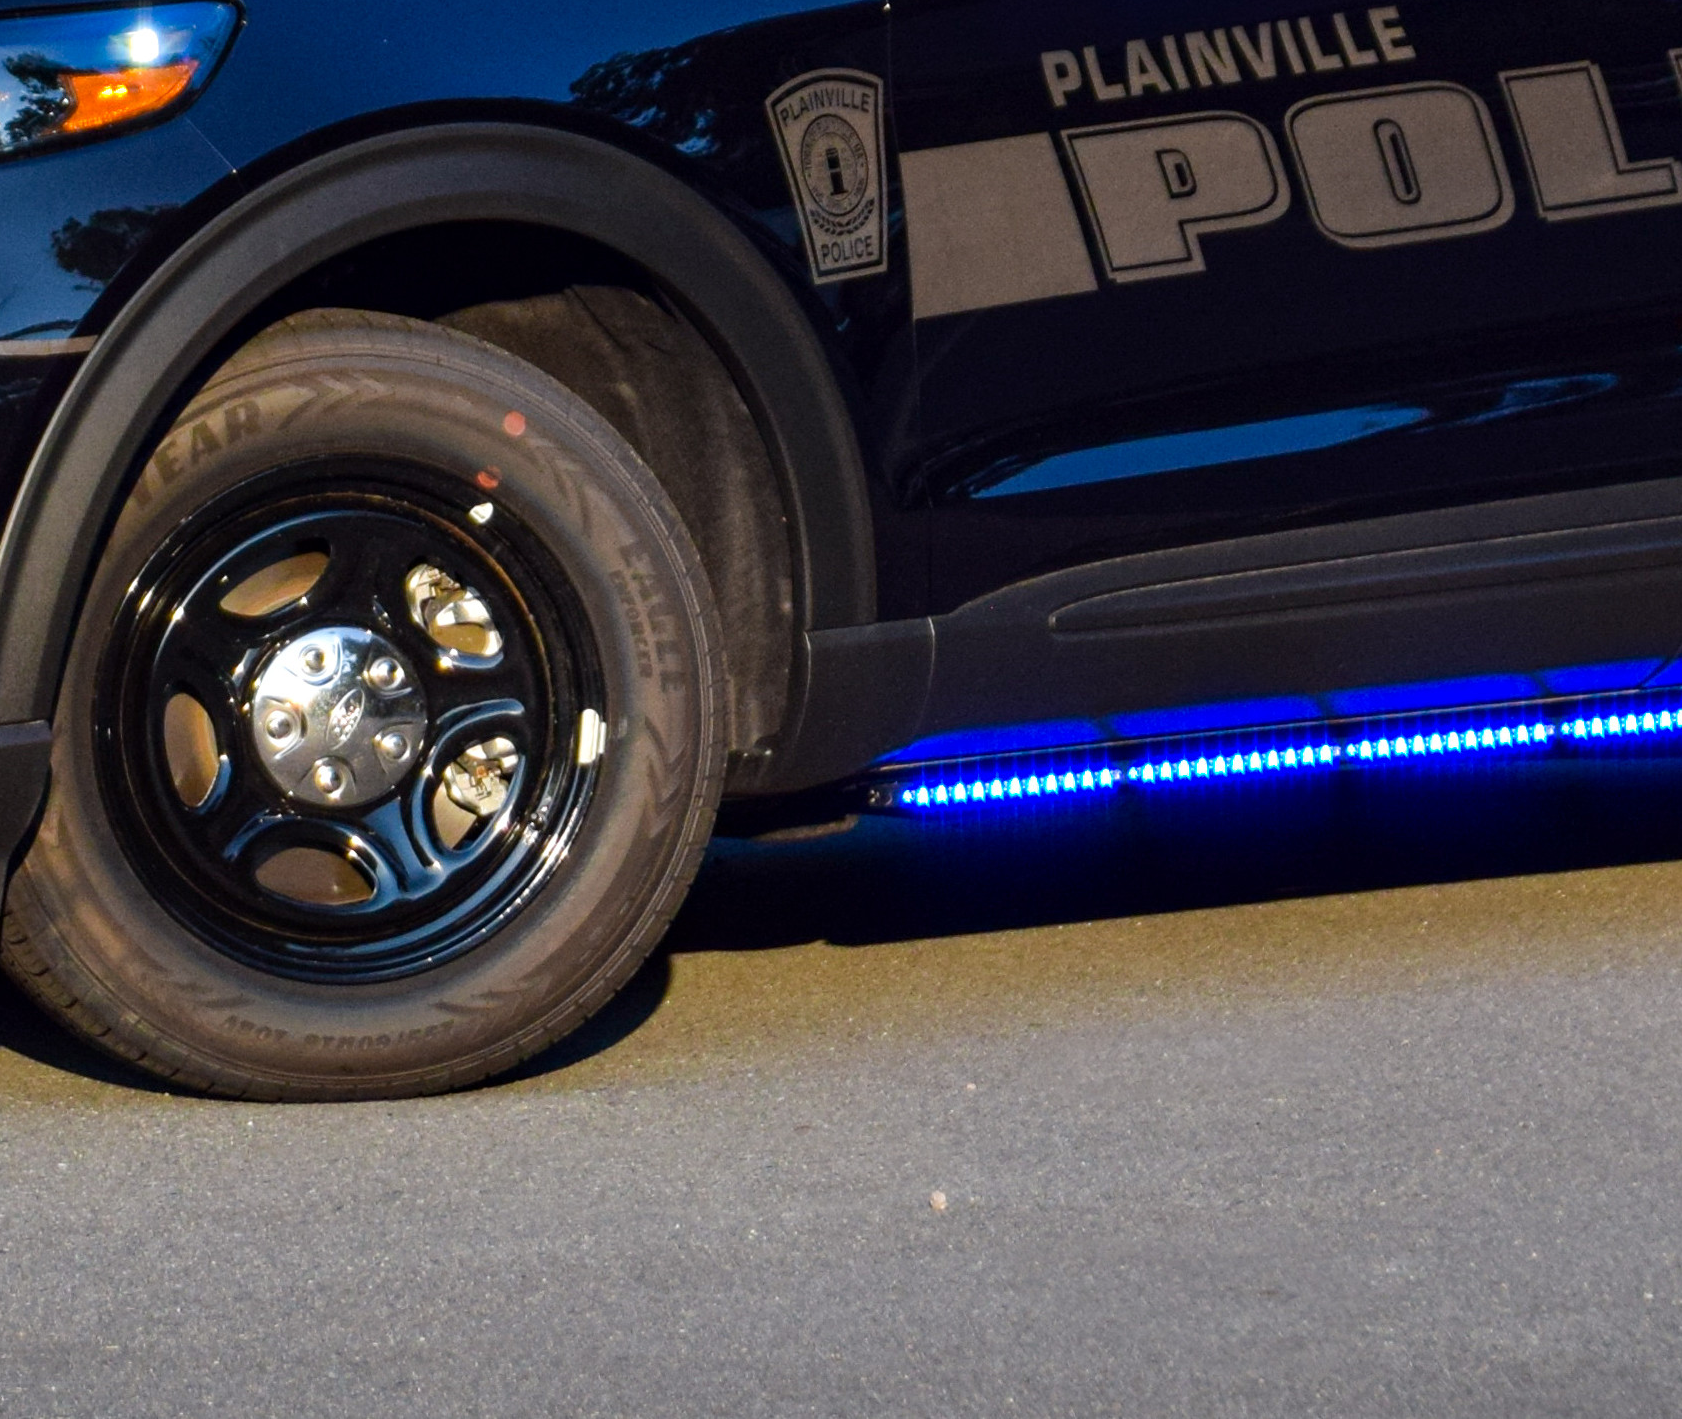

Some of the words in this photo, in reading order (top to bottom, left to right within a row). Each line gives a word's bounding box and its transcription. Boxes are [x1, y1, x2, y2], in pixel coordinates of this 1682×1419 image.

[1041, 4, 1417, 109] PLAINVILLE
[779, 89, 872, 126] PLAINVILLE
[820, 235, 875, 265] POLICE
